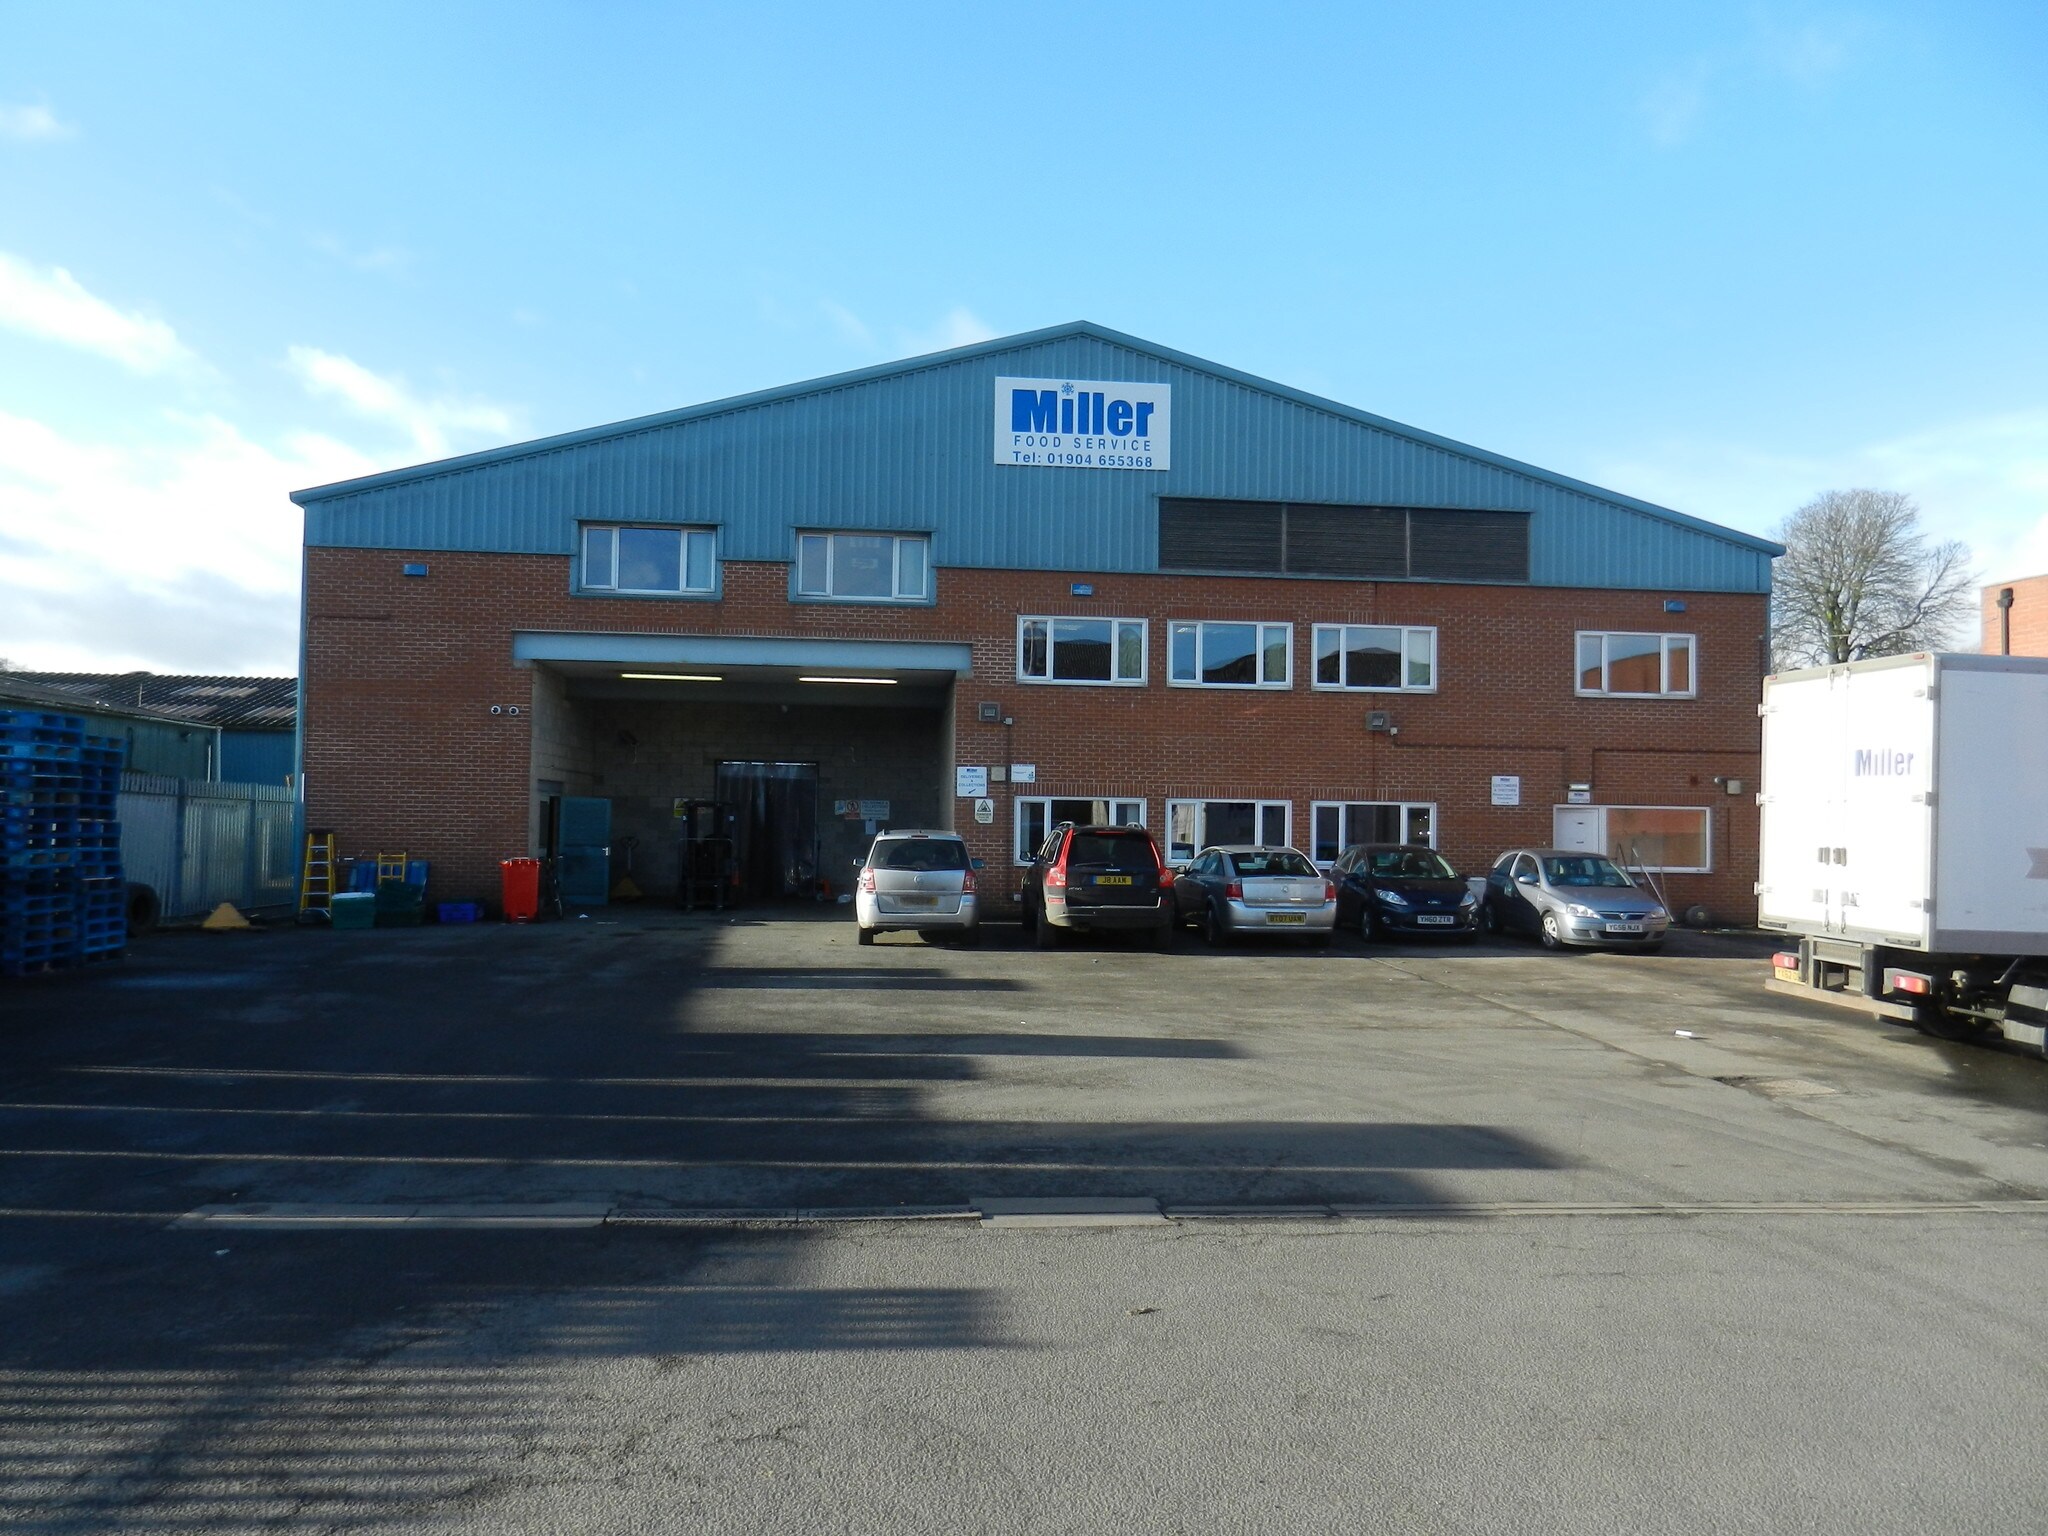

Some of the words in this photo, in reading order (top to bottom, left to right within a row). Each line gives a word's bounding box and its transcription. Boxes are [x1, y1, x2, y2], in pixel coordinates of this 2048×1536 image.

[1012, 383, 1154, 437] Miller
[1014, 435, 1061, 448] FOOD
[1073, 437, 1151, 451] SERVICE
[1013, 451, 1041, 464] Tel:
[1047, 452, 1092, 466] 01904
[1098, 454, 1153, 468] 655368
[1855, 748, 1914, 776] Miller
